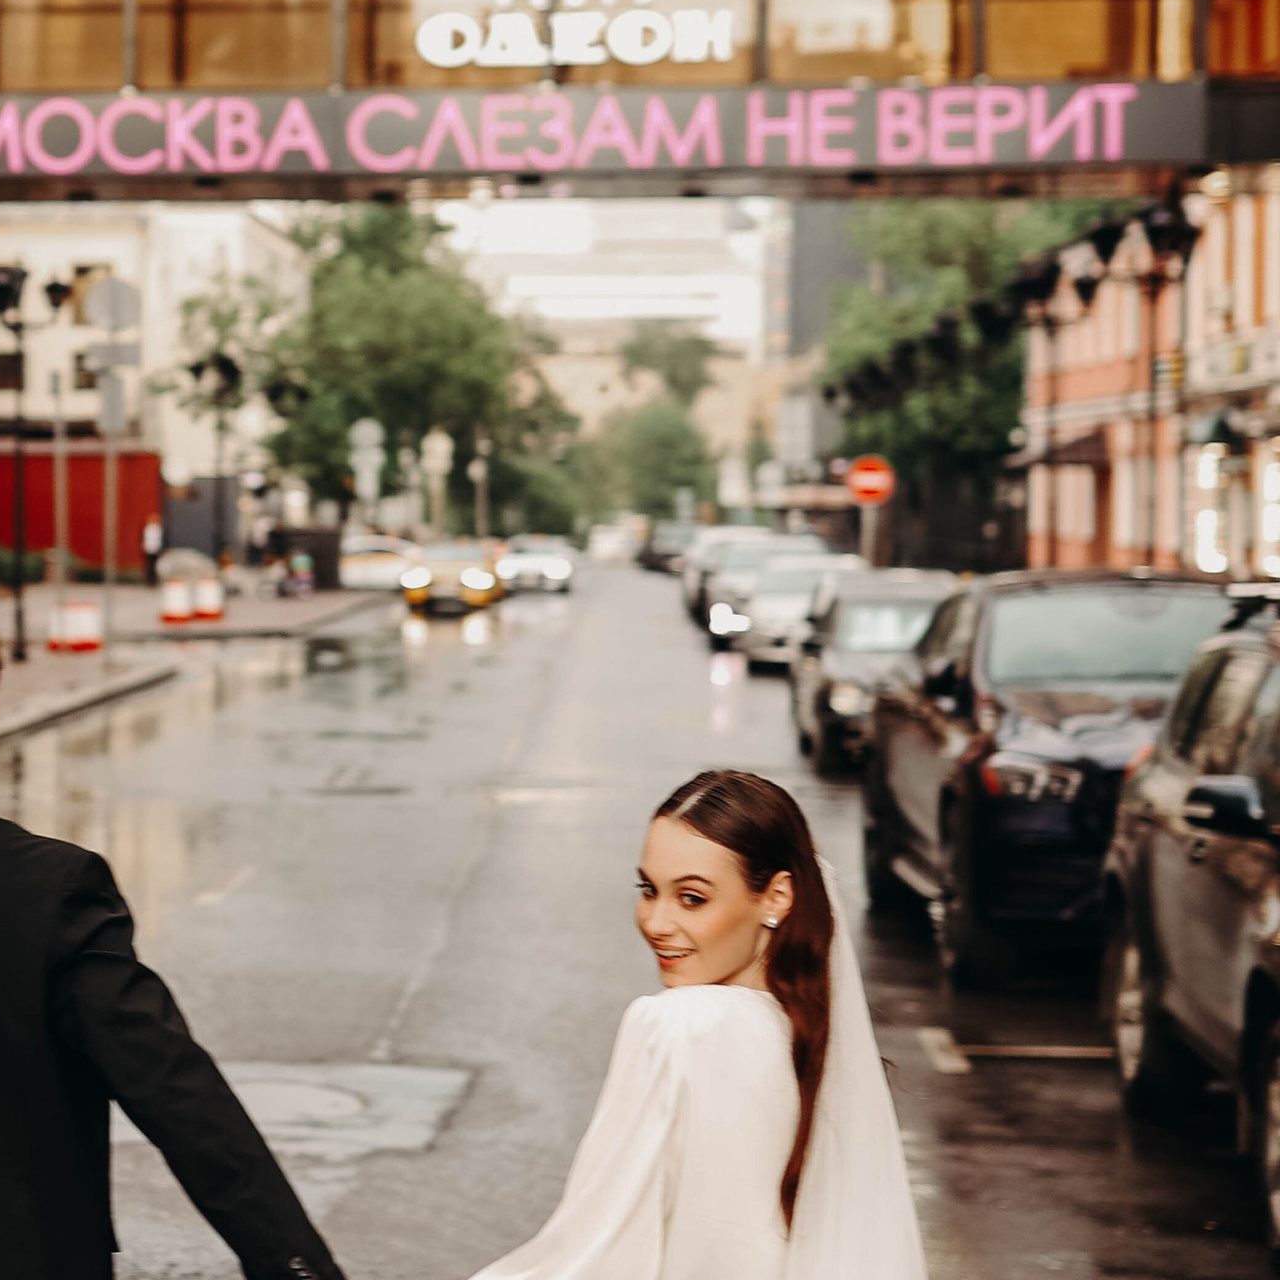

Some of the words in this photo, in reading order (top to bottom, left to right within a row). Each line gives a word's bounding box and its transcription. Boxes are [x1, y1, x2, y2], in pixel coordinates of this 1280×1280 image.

[346, 95, 722, 171] СЛЕЗАМ
[747, 90, 856, 166] НЕ
[876, 83, 1138, 163] ВЕРИТ
